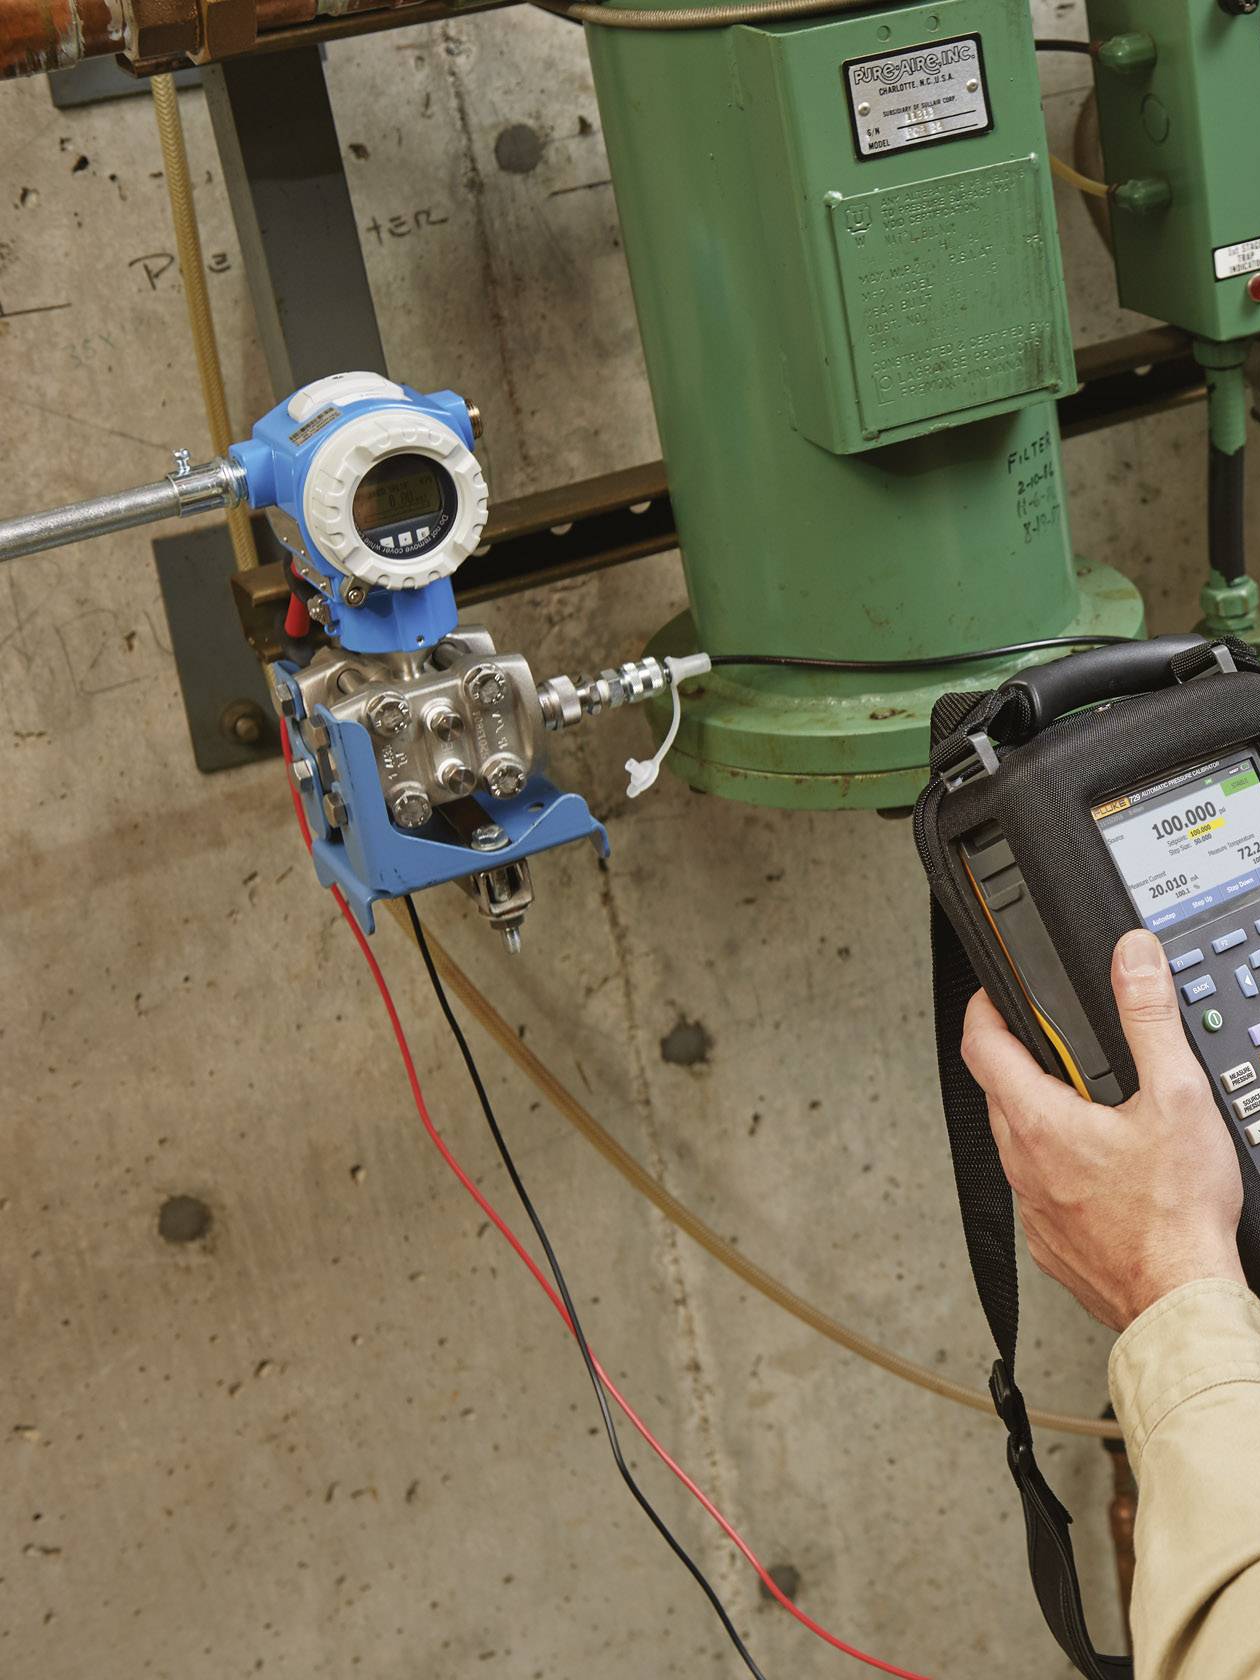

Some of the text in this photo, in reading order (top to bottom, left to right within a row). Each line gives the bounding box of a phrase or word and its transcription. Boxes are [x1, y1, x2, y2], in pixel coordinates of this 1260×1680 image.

[941, 46, 976, 66] INC.
[883, 106, 912, 118] SUBSIDIARY
[866, 127, 880, 137] S/N
[868, 139, 890, 150] MODEL
[1238, 251, 1254, 262] TRAP
[1008, 431, 1050, 474] FILTER
[382, 546, 404, 554] cover
[405, 536, 431, 552] remove
[1095, 799, 1127, 818] FLUKE
[1129, 794, 1140, 803] 729
[1141, 782, 1168, 797] AUTOMATIC
[1168, 772, 1192, 786] PRESSURE
[1192, 761, 1220, 776] CALIBRATOR
[1152, 801, 1217, 840] 100.000
[1190, 824, 1211, 838] 100.000
[1107, 834, 1124, 845] Source
[1208, 833, 1255, 856] Measure Temperature
[1148, 870, 1166, 882] Current
[1149, 874, 1199, 899] 20.010 mA
[1175, 888, 1190, 898] 100.1
[1192, 895, 1213, 908] Step Up
[1152, 912, 1176, 926] Autostep
[1221, 939, 1229, 947] F2
[1177, 960, 1184, 968] F1
[1192, 982, 1210, 994] BACK
[1229, 1065, 1251, 1080] MEASURE
[1232, 1073, 1254, 1086] PRESSURE
